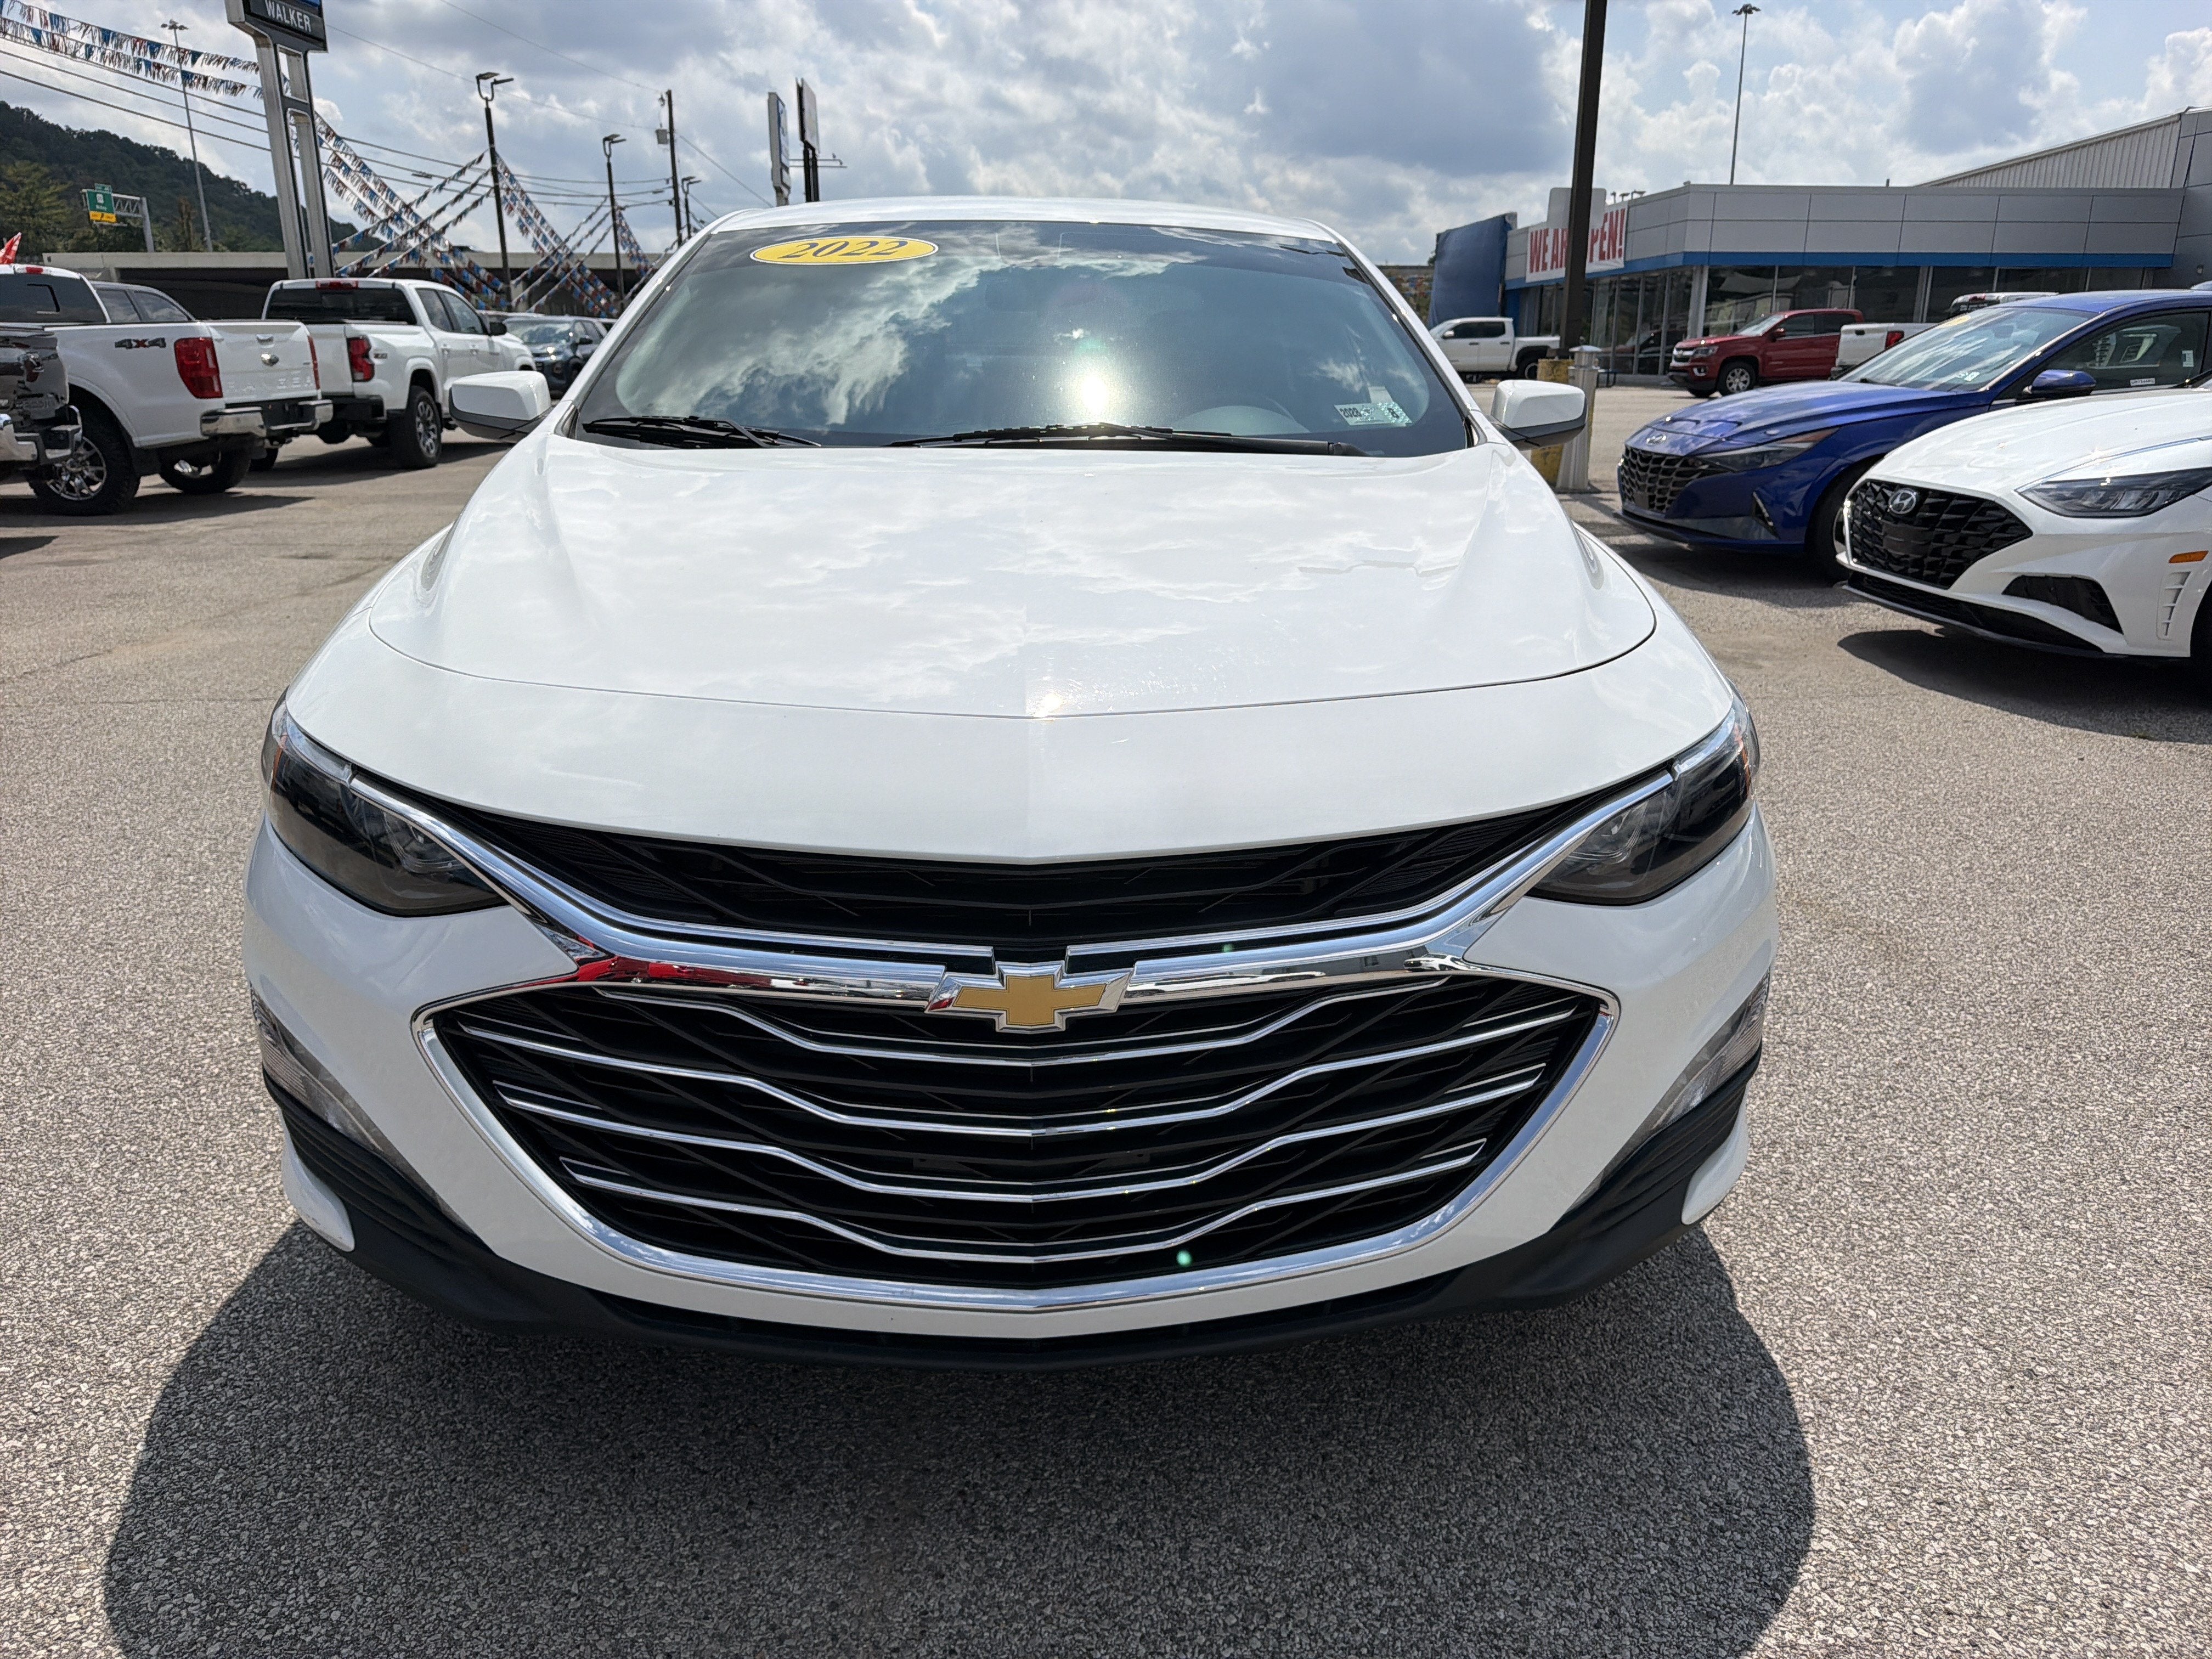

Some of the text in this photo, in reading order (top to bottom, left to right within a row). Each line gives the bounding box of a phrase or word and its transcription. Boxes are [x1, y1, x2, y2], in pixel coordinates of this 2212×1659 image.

[265, 0, 312, 32] WALKER
[777, 240, 909, 258] 2022
[1530, 208, 1626, 273] WE AR PEN!
